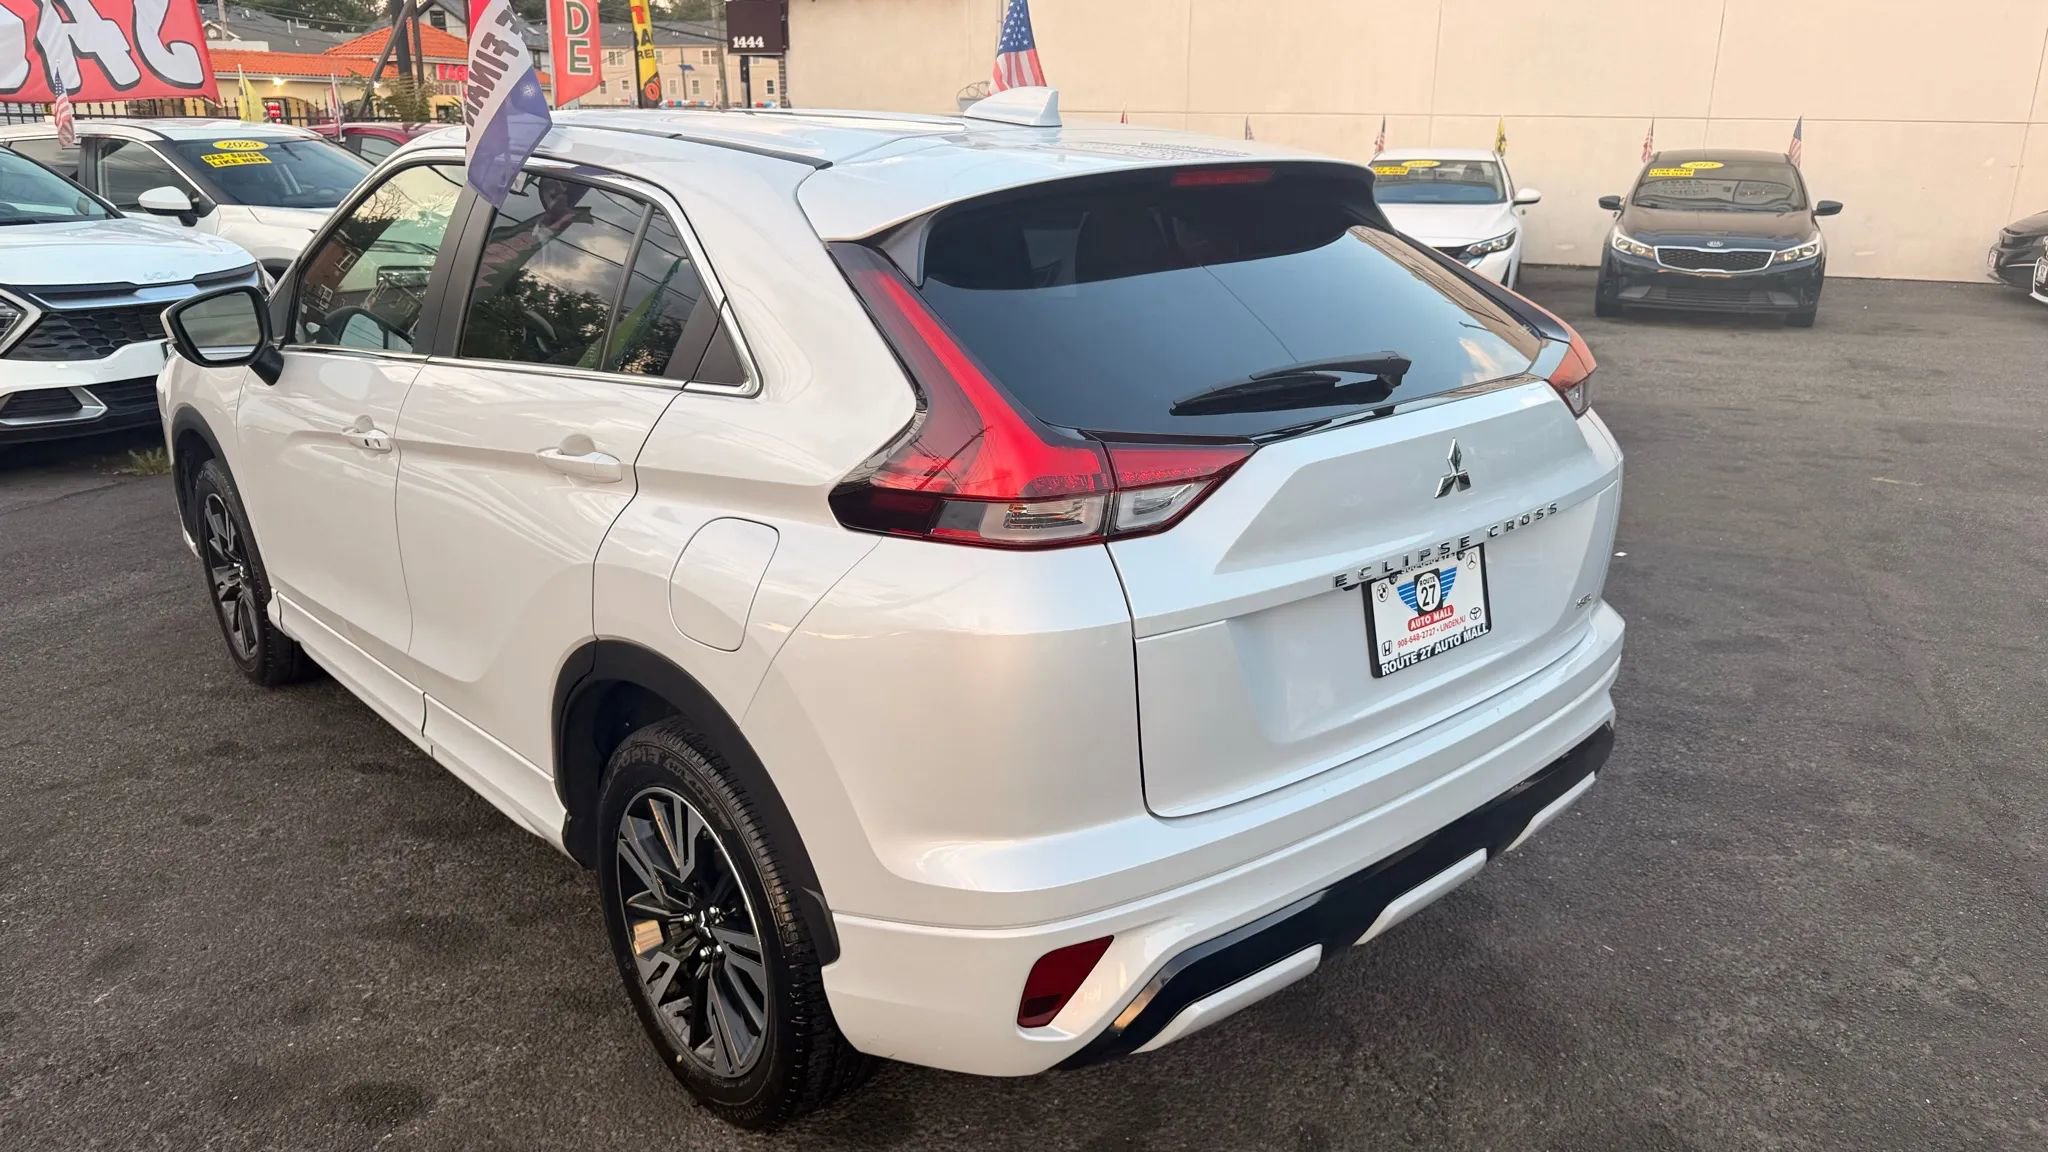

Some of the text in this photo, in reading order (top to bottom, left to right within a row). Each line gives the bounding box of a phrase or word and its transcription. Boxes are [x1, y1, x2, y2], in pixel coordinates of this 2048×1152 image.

[732, 36, 765, 48] 1444
[224, 141, 259, 149] 2023
[210, 158, 241, 167] LIKE
[1333, 535, 1470, 588] ECLIPSE
[1485, 502, 1558, 538] CROSS
[1419, 576, 1436, 586] ROUTE
[1420, 583, 1437, 607] 27
[1410, 605, 1453, 630] AUTO MALL
[1397, 627, 1436, 648] 908-648-2727
[1381, 623, 1489, 676] ROUTE 27 AUTO MALL
